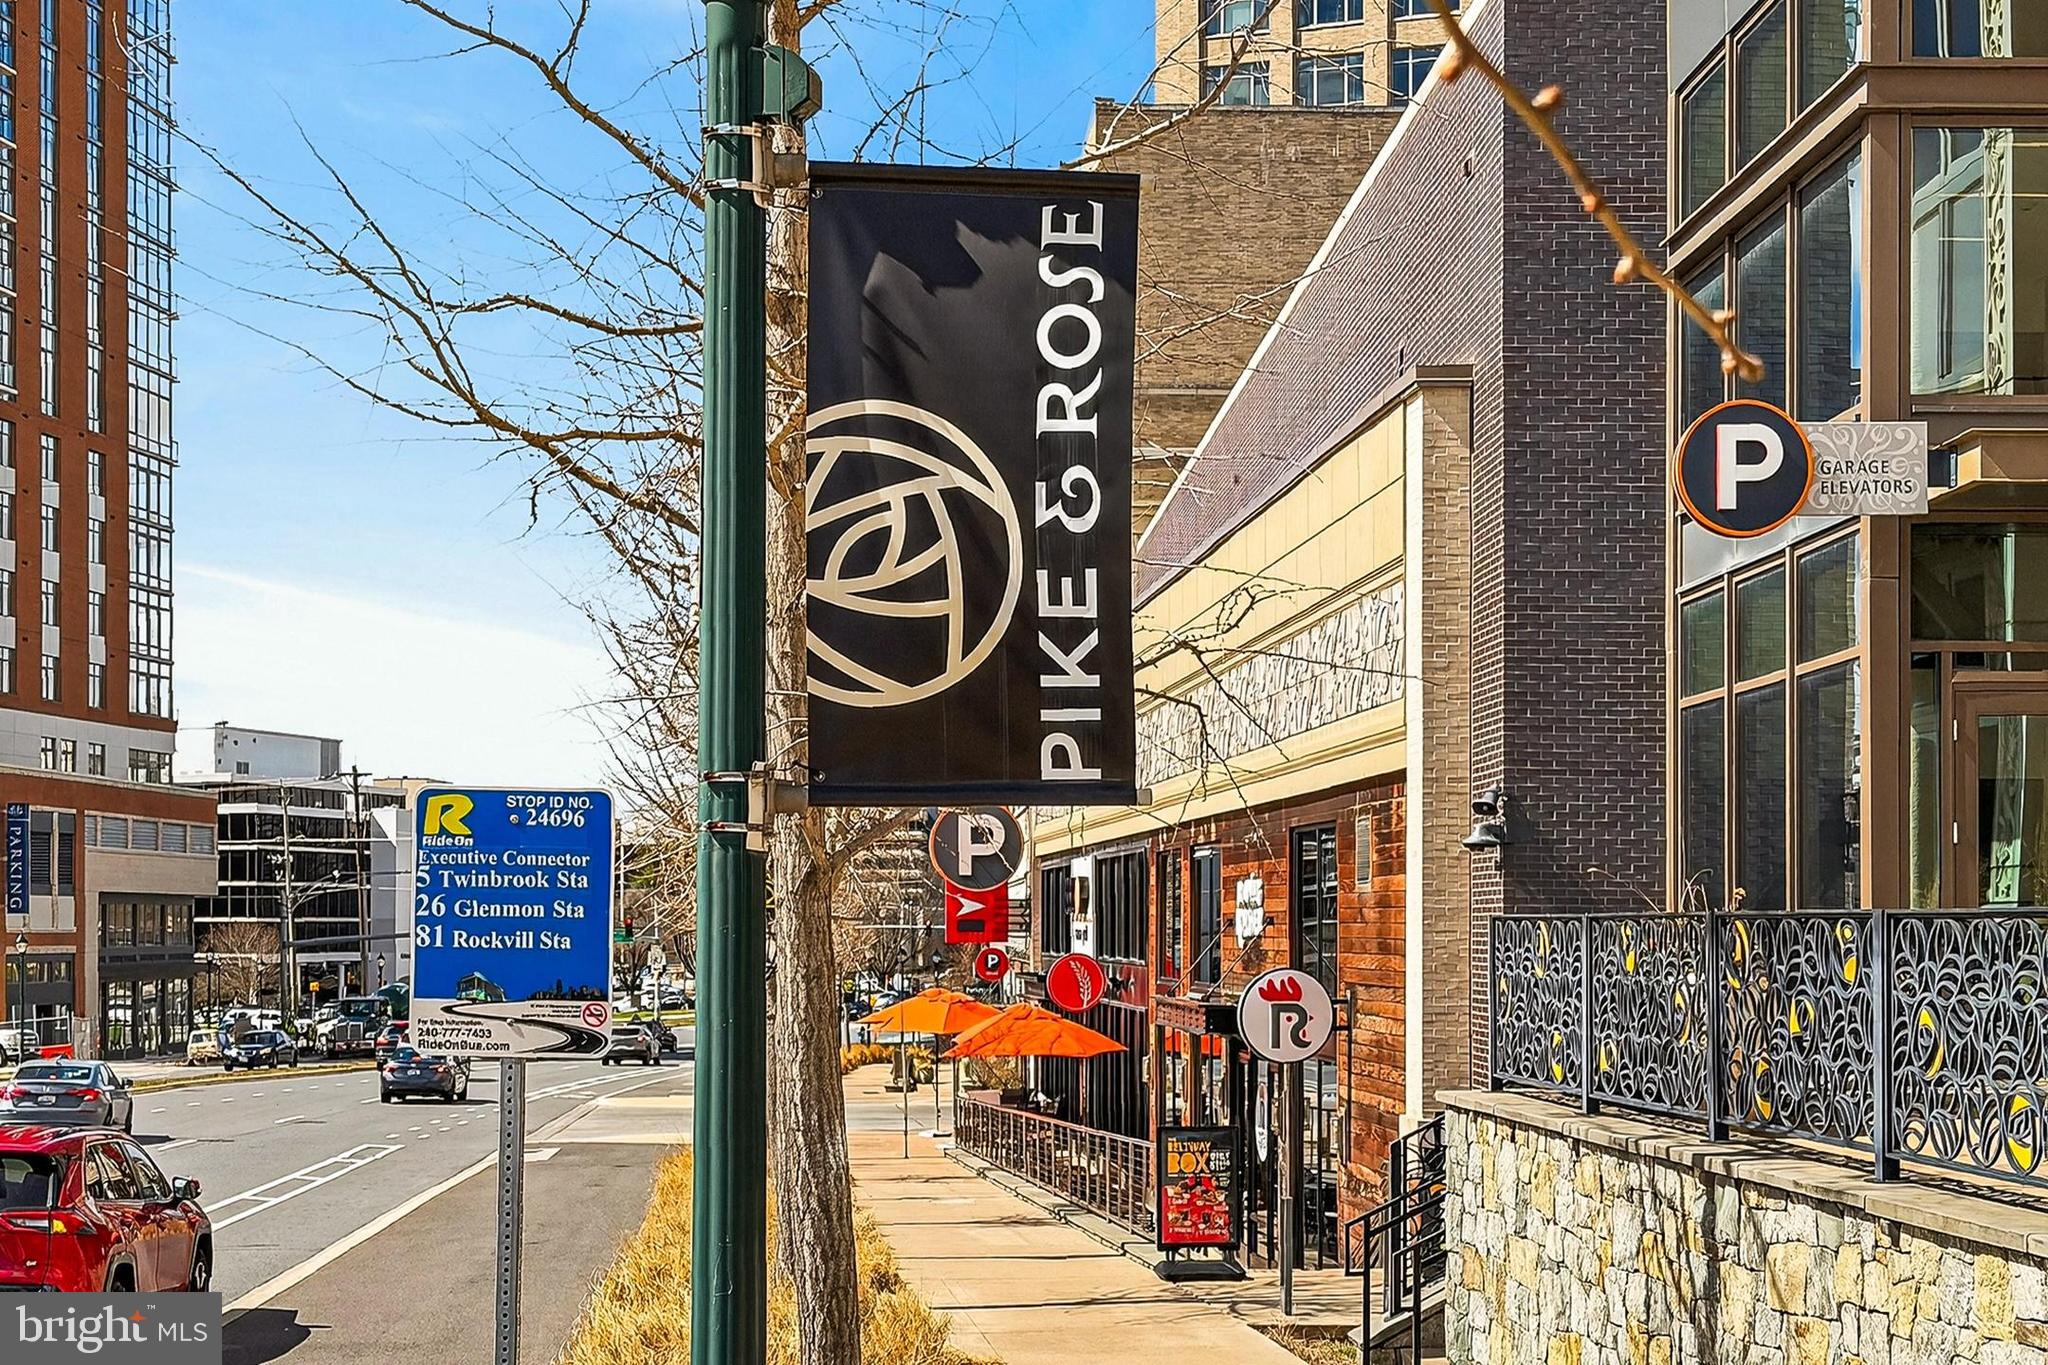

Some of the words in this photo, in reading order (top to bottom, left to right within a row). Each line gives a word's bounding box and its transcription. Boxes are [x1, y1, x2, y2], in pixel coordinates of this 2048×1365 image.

[1036, 200, 1104, 439] ROSE
[1716, 423, 1784, 511] P
[1820, 460, 1889, 475] GARAGE
[1035, 464, 1101, 533] &
[1820, 479, 1913, 495] ELEVATORS
[1036, 568, 1101, 780] PIKE
[423, 793, 474, 835] R
[506, 795, 546, 808] STOP
[549, 796, 564, 808] ID
[568, 796, 594, 810] NO.
[526, 808, 585, 828] 24696
[957, 813, 1006, 876] P
[9, 826, 23, 909] PARKING
[418, 849, 498, 866] Executive
[502, 850, 591, 867] Connector
[416, 865, 431, 888] 5
[438, 870, 550, 888] Twinbrook
[556, 870, 589, 889] Sta
[415, 893, 447, 917] 26
[454, 899, 545, 918] Glenmon
[553, 900, 585, 918] Sta
[415, 924, 444, 948] 81
[452, 930, 534, 949] Rockvill
[540, 931, 571, 949] Sta
[986, 954, 999, 969] P
[1167, 1152, 1211, 1174] BOX
